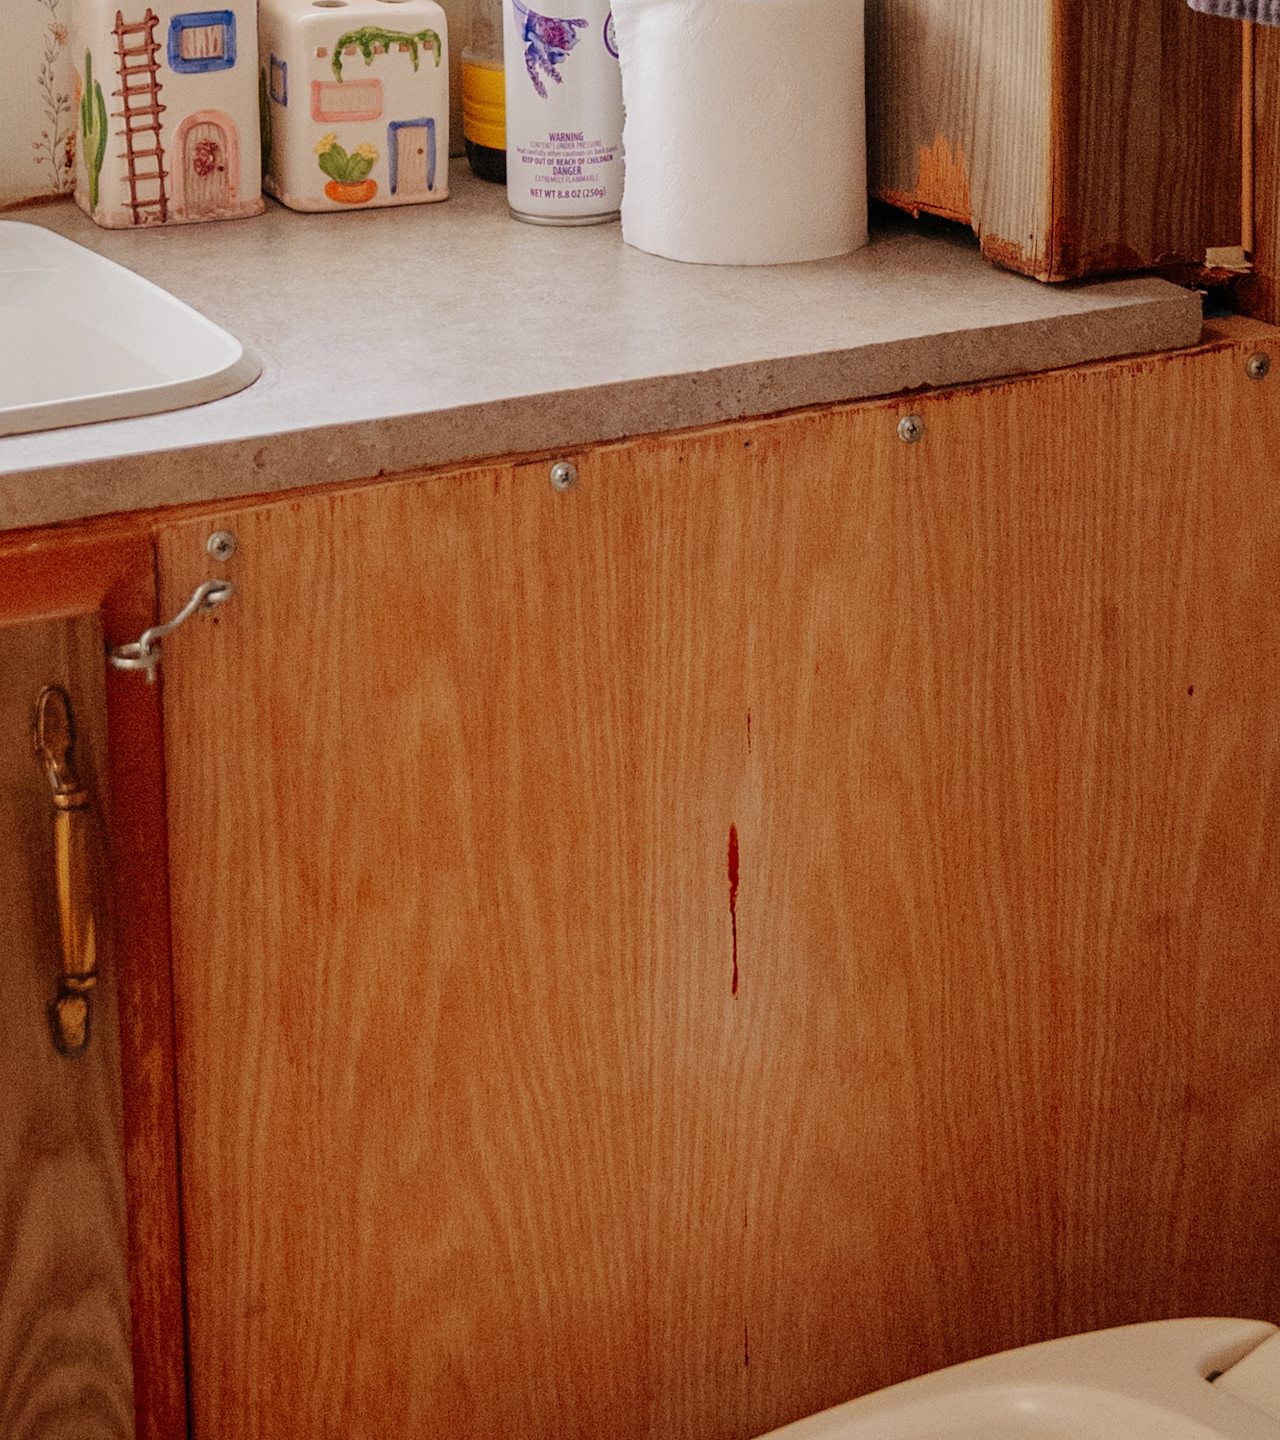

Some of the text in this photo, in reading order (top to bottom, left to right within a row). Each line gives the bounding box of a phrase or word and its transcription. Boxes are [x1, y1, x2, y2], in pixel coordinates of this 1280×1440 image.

[549, 132, 584, 142] WARNING
[534, 157, 546, 165] OUT
[577, 157, 585, 165] OF
[587, 154, 613, 164] CHILDREN
[552, 166, 582, 176] DANGER
[530, 187, 606, 198] NET WT 8.8 OZ (250g)
